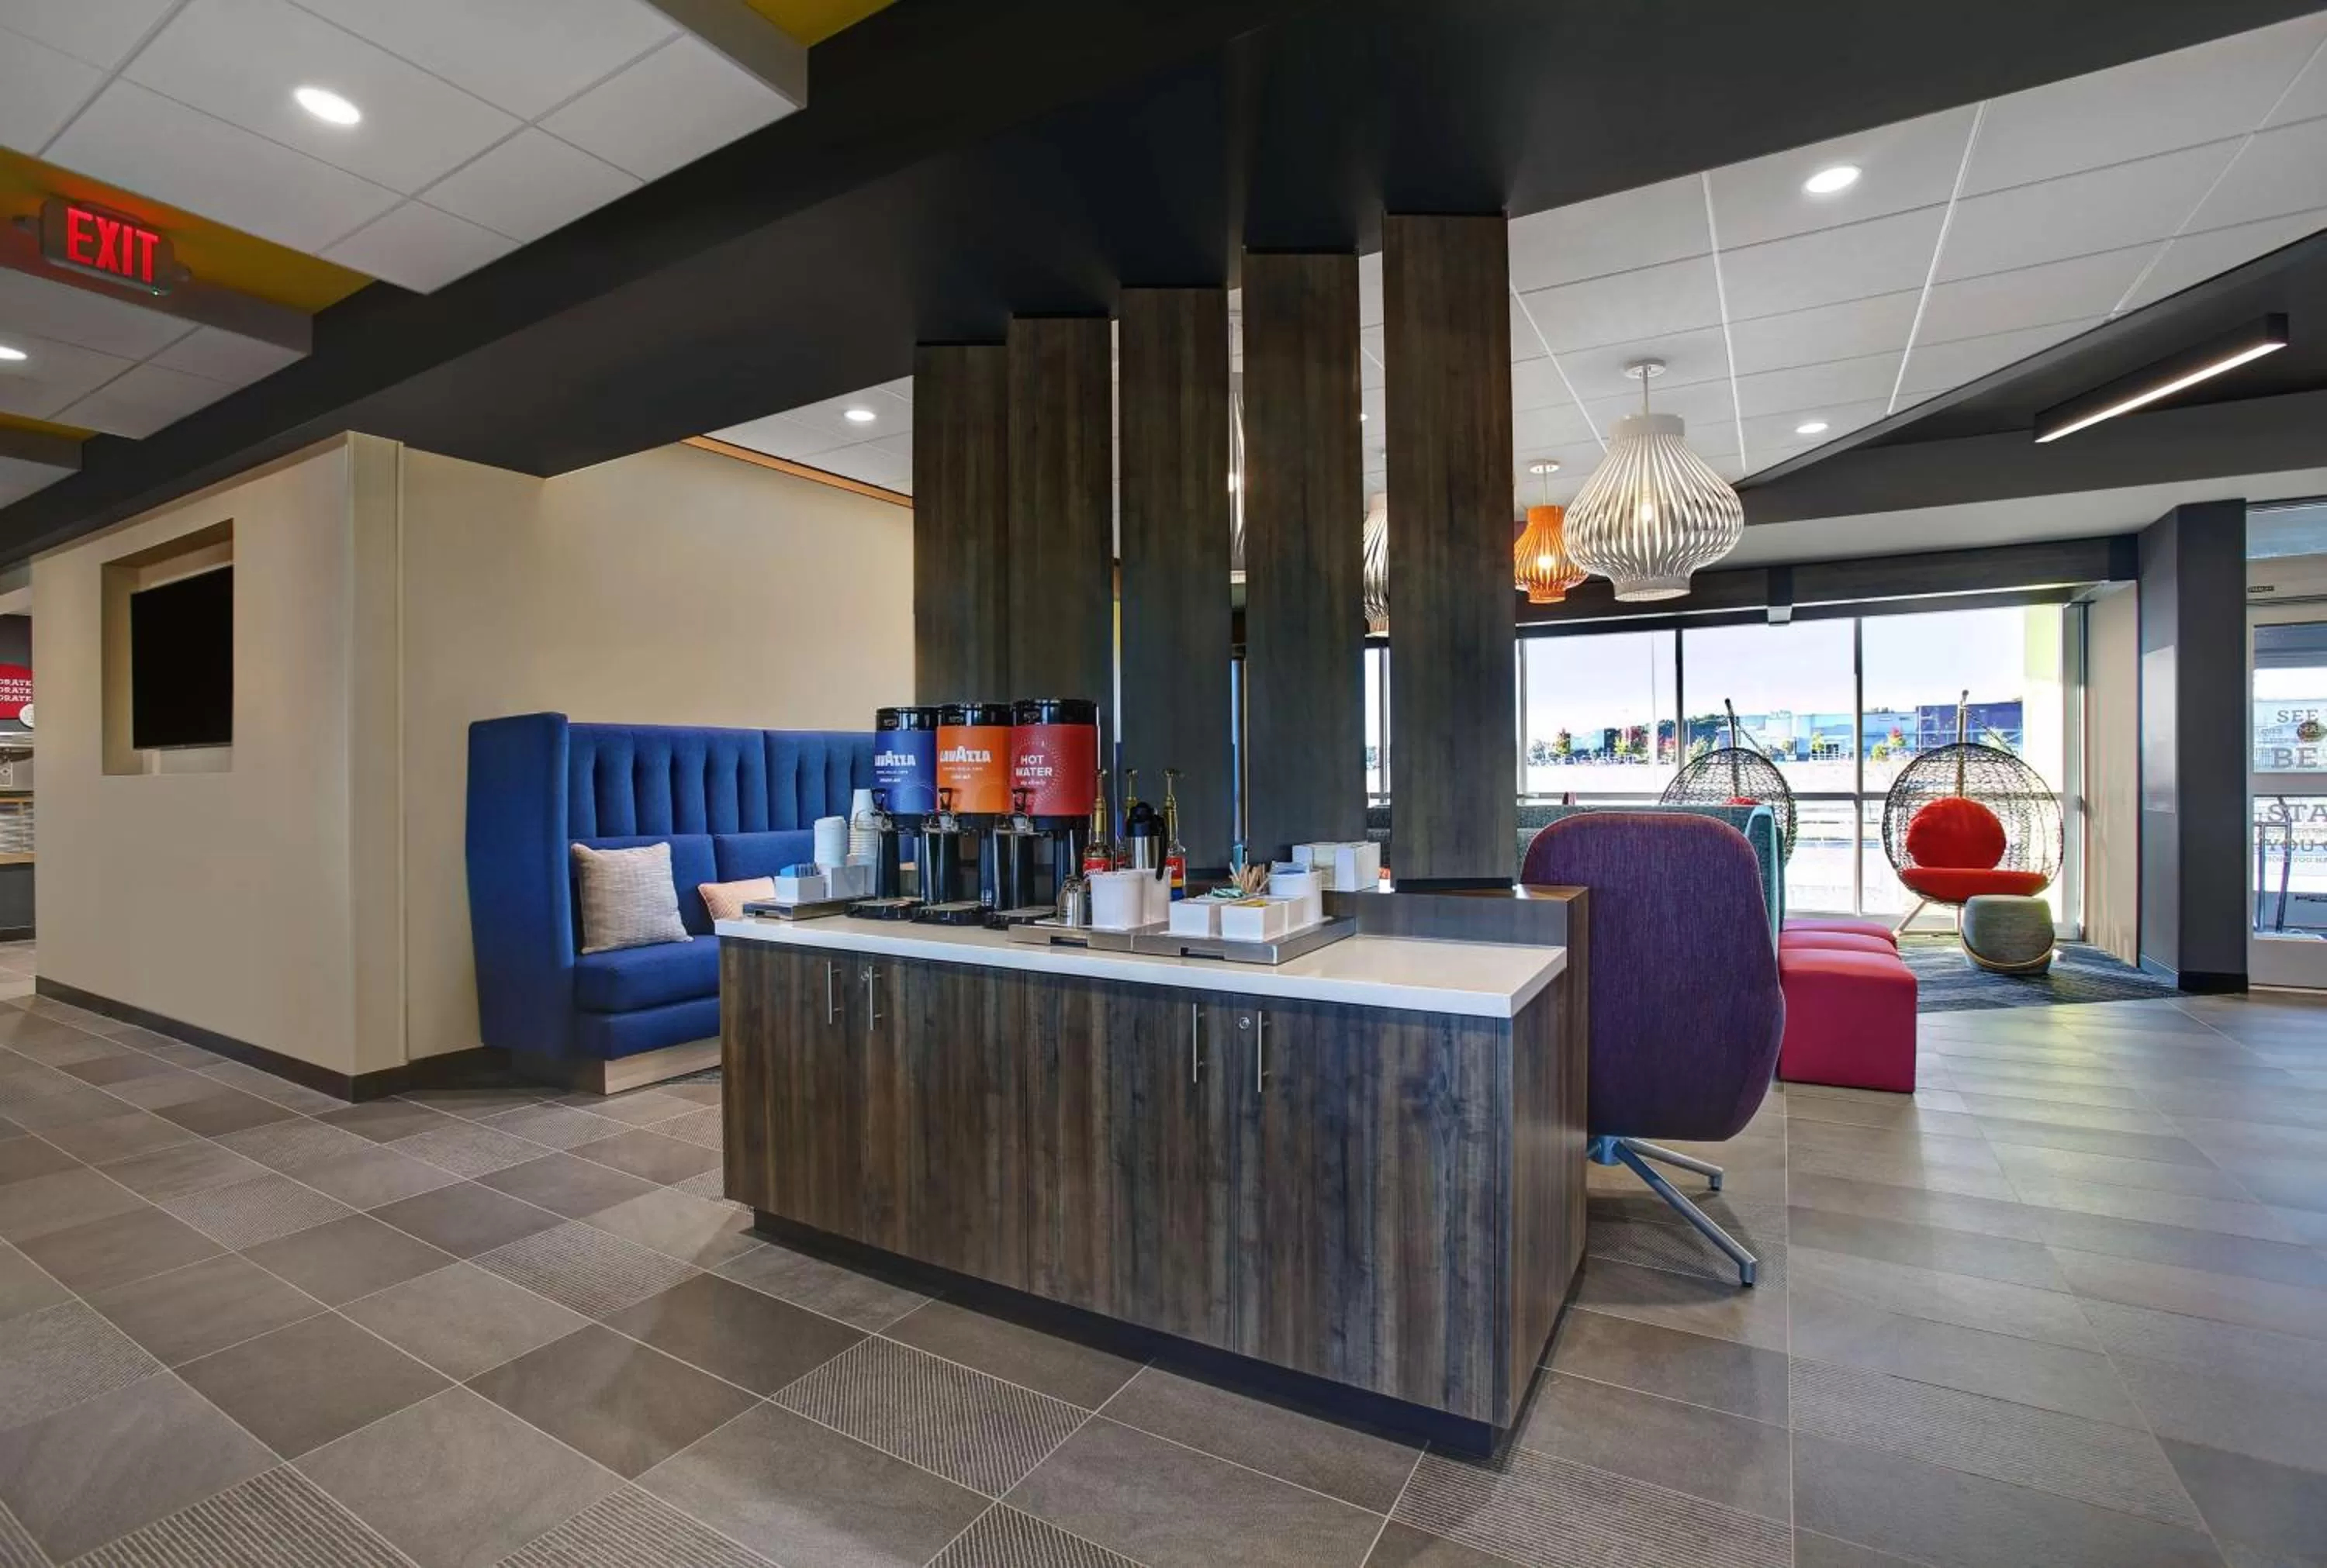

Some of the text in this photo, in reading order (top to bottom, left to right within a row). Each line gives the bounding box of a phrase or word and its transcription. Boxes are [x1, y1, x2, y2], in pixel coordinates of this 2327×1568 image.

[67, 207, 160, 284] EXIT
[2277, 709, 2318, 723] SEE
[1020, 755, 1045, 765] HOT
[2271, 747, 2317, 768] BE
[1015, 766, 1053, 777] WATER
